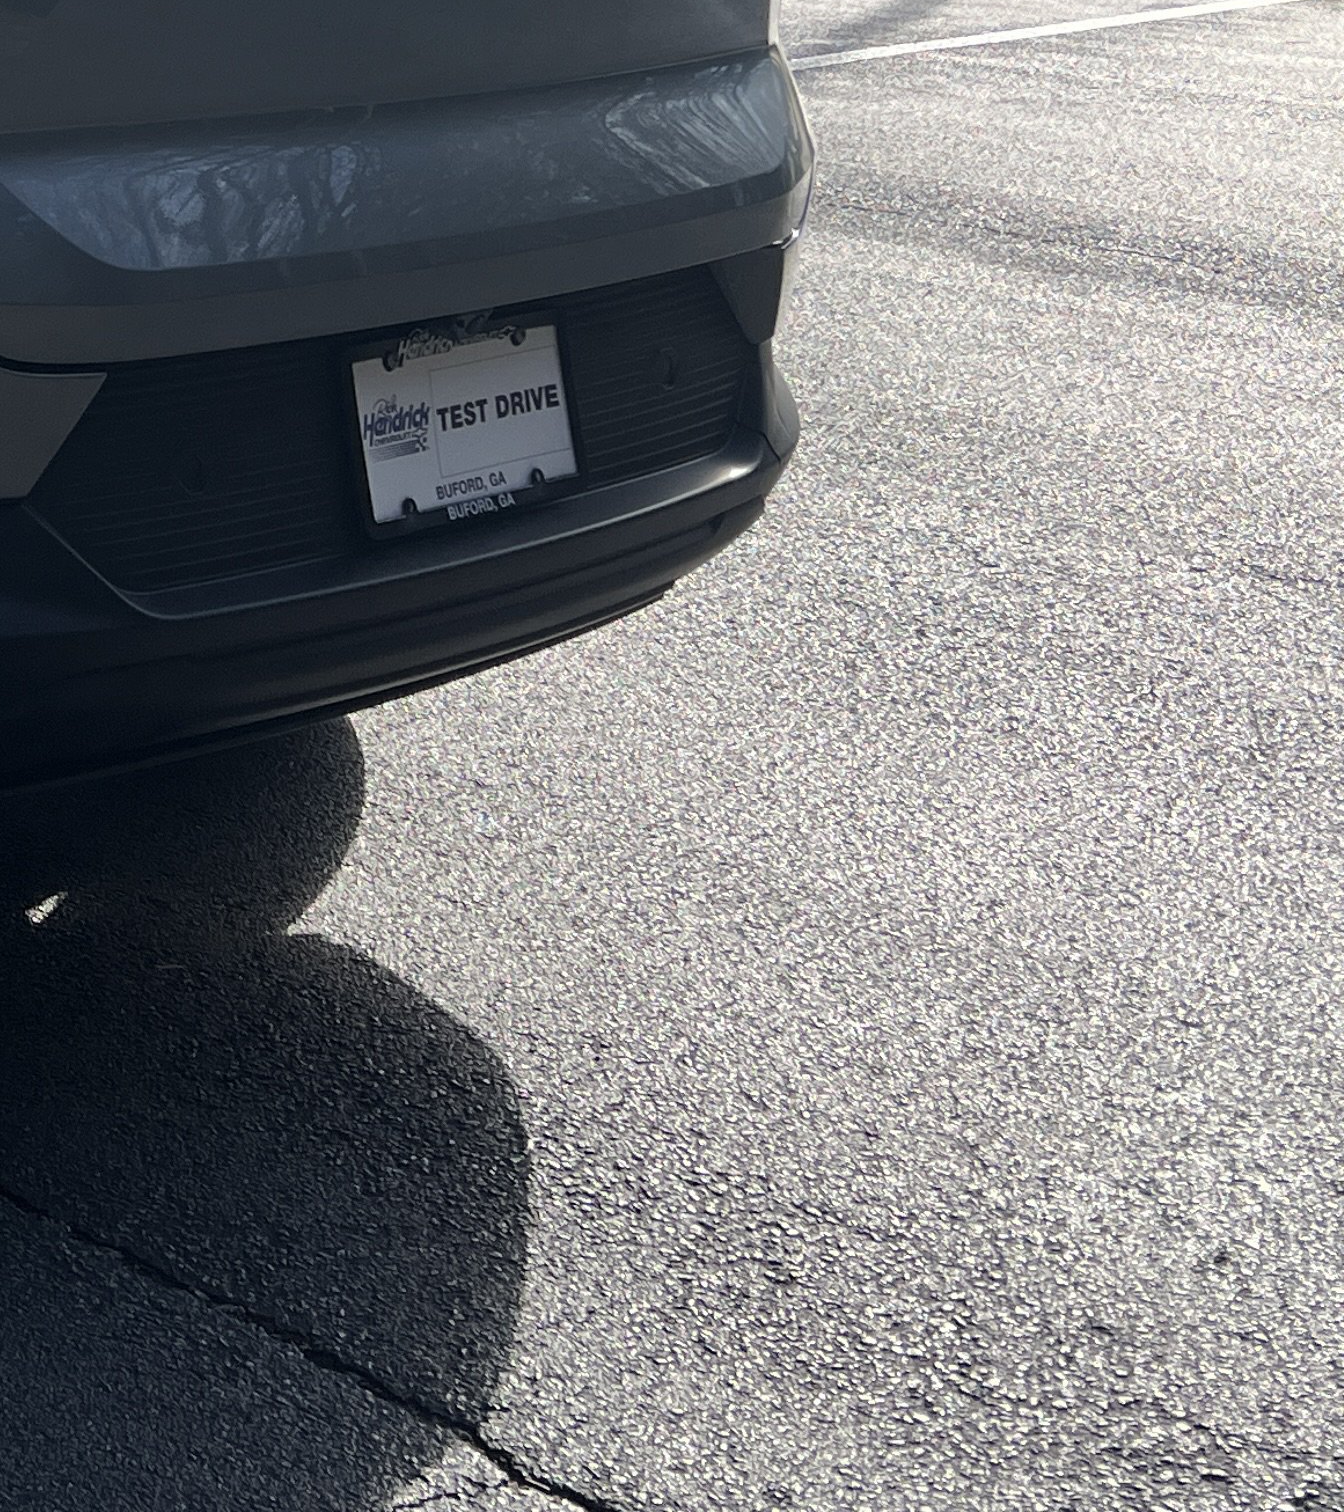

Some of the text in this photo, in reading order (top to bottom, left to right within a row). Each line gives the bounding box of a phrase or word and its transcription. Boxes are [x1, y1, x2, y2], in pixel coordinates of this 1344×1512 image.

[363, 402, 430, 447] Hendrick
[436, 384, 560, 431] TEST DRIVE
[436, 471, 507, 500] BUFORD, GA
[447, 492, 516, 520] BUFORD, GA
